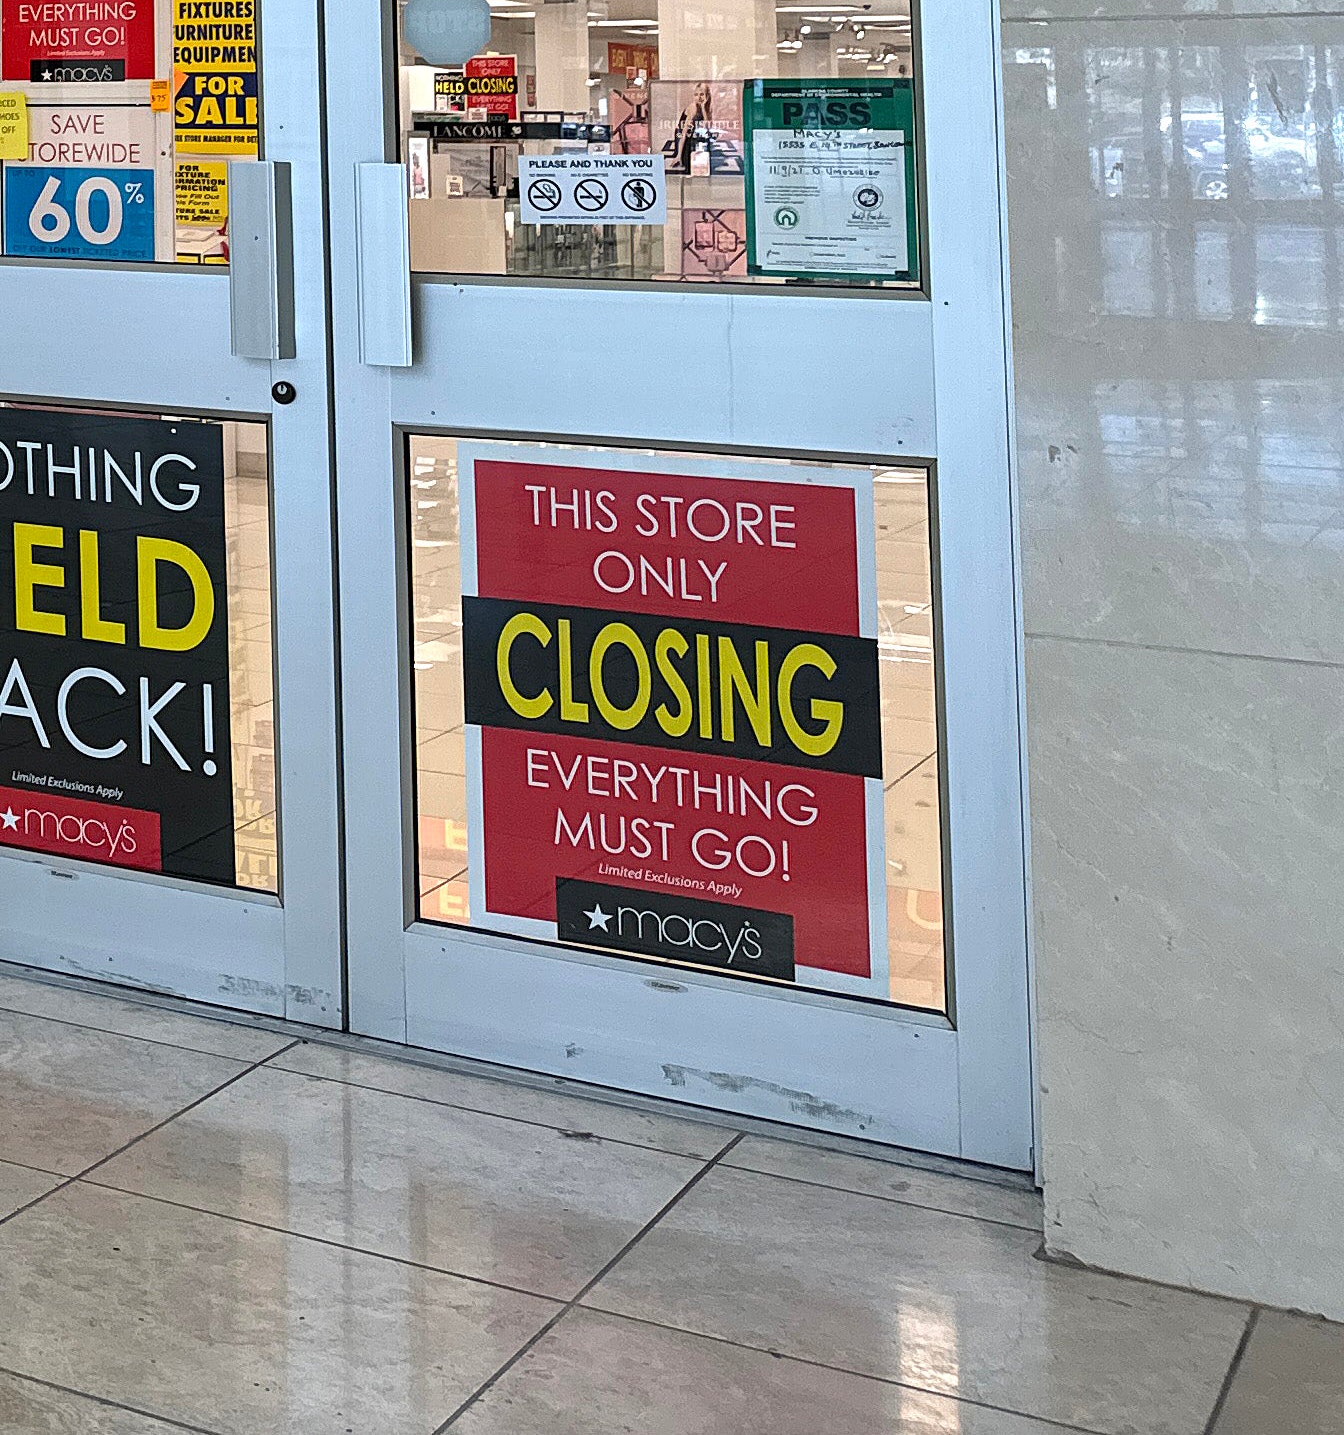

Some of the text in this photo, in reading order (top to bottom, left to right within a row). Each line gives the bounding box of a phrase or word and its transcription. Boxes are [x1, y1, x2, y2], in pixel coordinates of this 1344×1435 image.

[19, 1, 137, 23] EVERYTHING
[179, 1, 253, 19] FIXTURES
[29, 27, 125, 47] MUST GO!
[174, 24, 253, 41] URNITURE
[174, 46, 255, 64] EQUIPMEN
[195, 76, 244, 95] FOR
[435, 82, 465, 93] HELD
[468, 77, 515, 93] CLOSING
[175, 96, 258, 125] SALE
[782, 102, 872, 126] PASS
[1, 126, 16, 134] OFF
[51, 114, 105, 135] SAVE
[18, 142, 140, 164] TOREWIDE
[528, 159, 653, 168] PLEASE AND THANK YOU
[29, 175, 145, 245] 60%
[524, 484, 797, 549] THIS STORE
[593, 550, 728, 603] ONLY
[496, 612, 845, 757] CLOSING
[12, 770, 123, 800] Limited Exclusions Apply
[527, 748, 819, 827] EVERYTHING
[24, 808, 137, 858] macy's
[554, 807, 791, 882] MUST GO!
[599, 863, 743, 899] Limited Exclusions Apply
[617, 906, 762, 964] macy's
